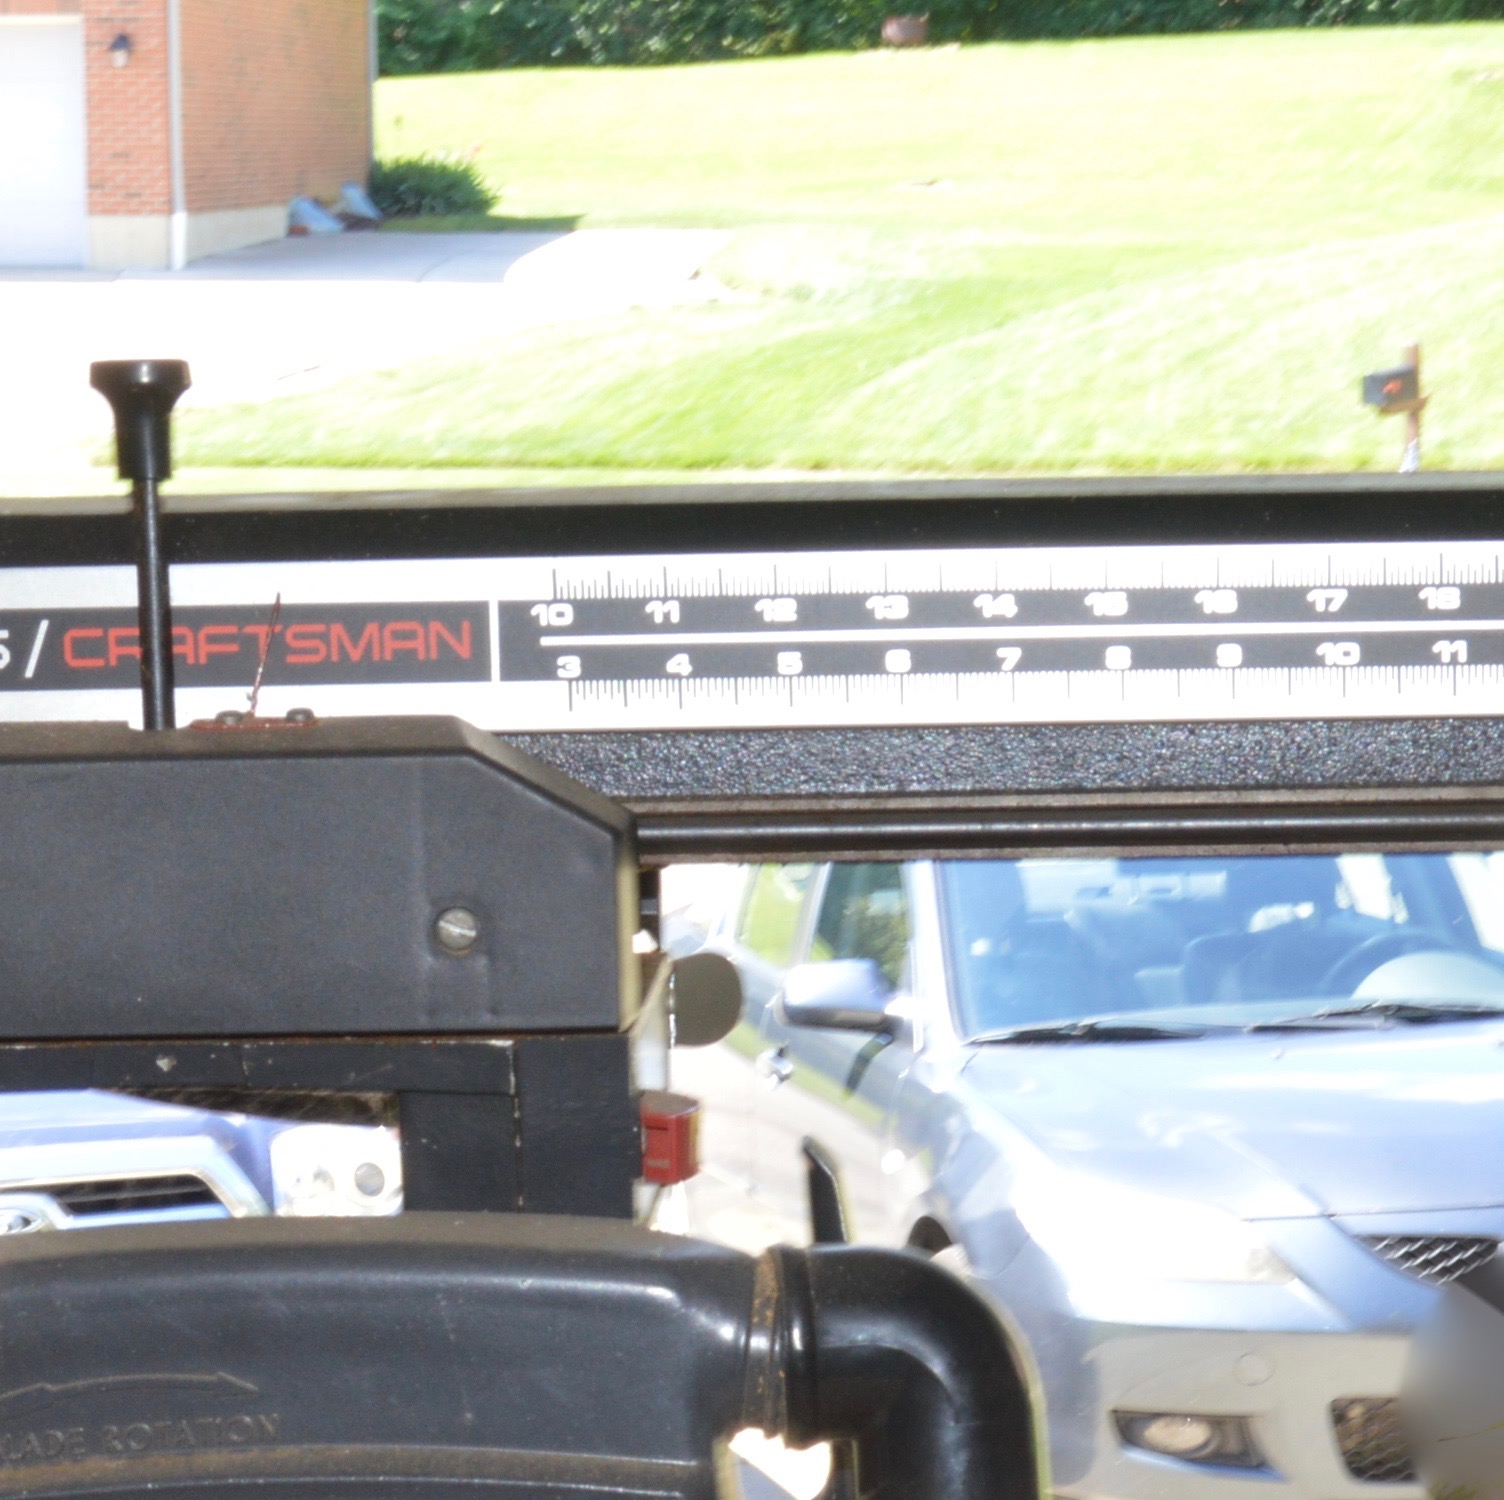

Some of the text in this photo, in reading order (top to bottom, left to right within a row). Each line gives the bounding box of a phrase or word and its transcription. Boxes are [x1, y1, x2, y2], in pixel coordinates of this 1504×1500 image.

[530, 602, 574, 627] 10
[644, 600, 681, 624] 11
[754, 597, 798, 622] 12
[865, 595, 911, 620] 13
[973, 593, 1018, 619] 14
[1305, 587, 1349, 613] 17
[1418, 586, 1462, 611] 18
[557, 655, 582, 679] 3
[665, 653, 693, 677] 4
[777, 651, 804, 676] 5
[996, 646, 1023, 672] 7
[1315, 642, 1362, 666] 10
[1432, 640, 1468, 664] 11
[99, 1412, 281, 1453] ROTATION
